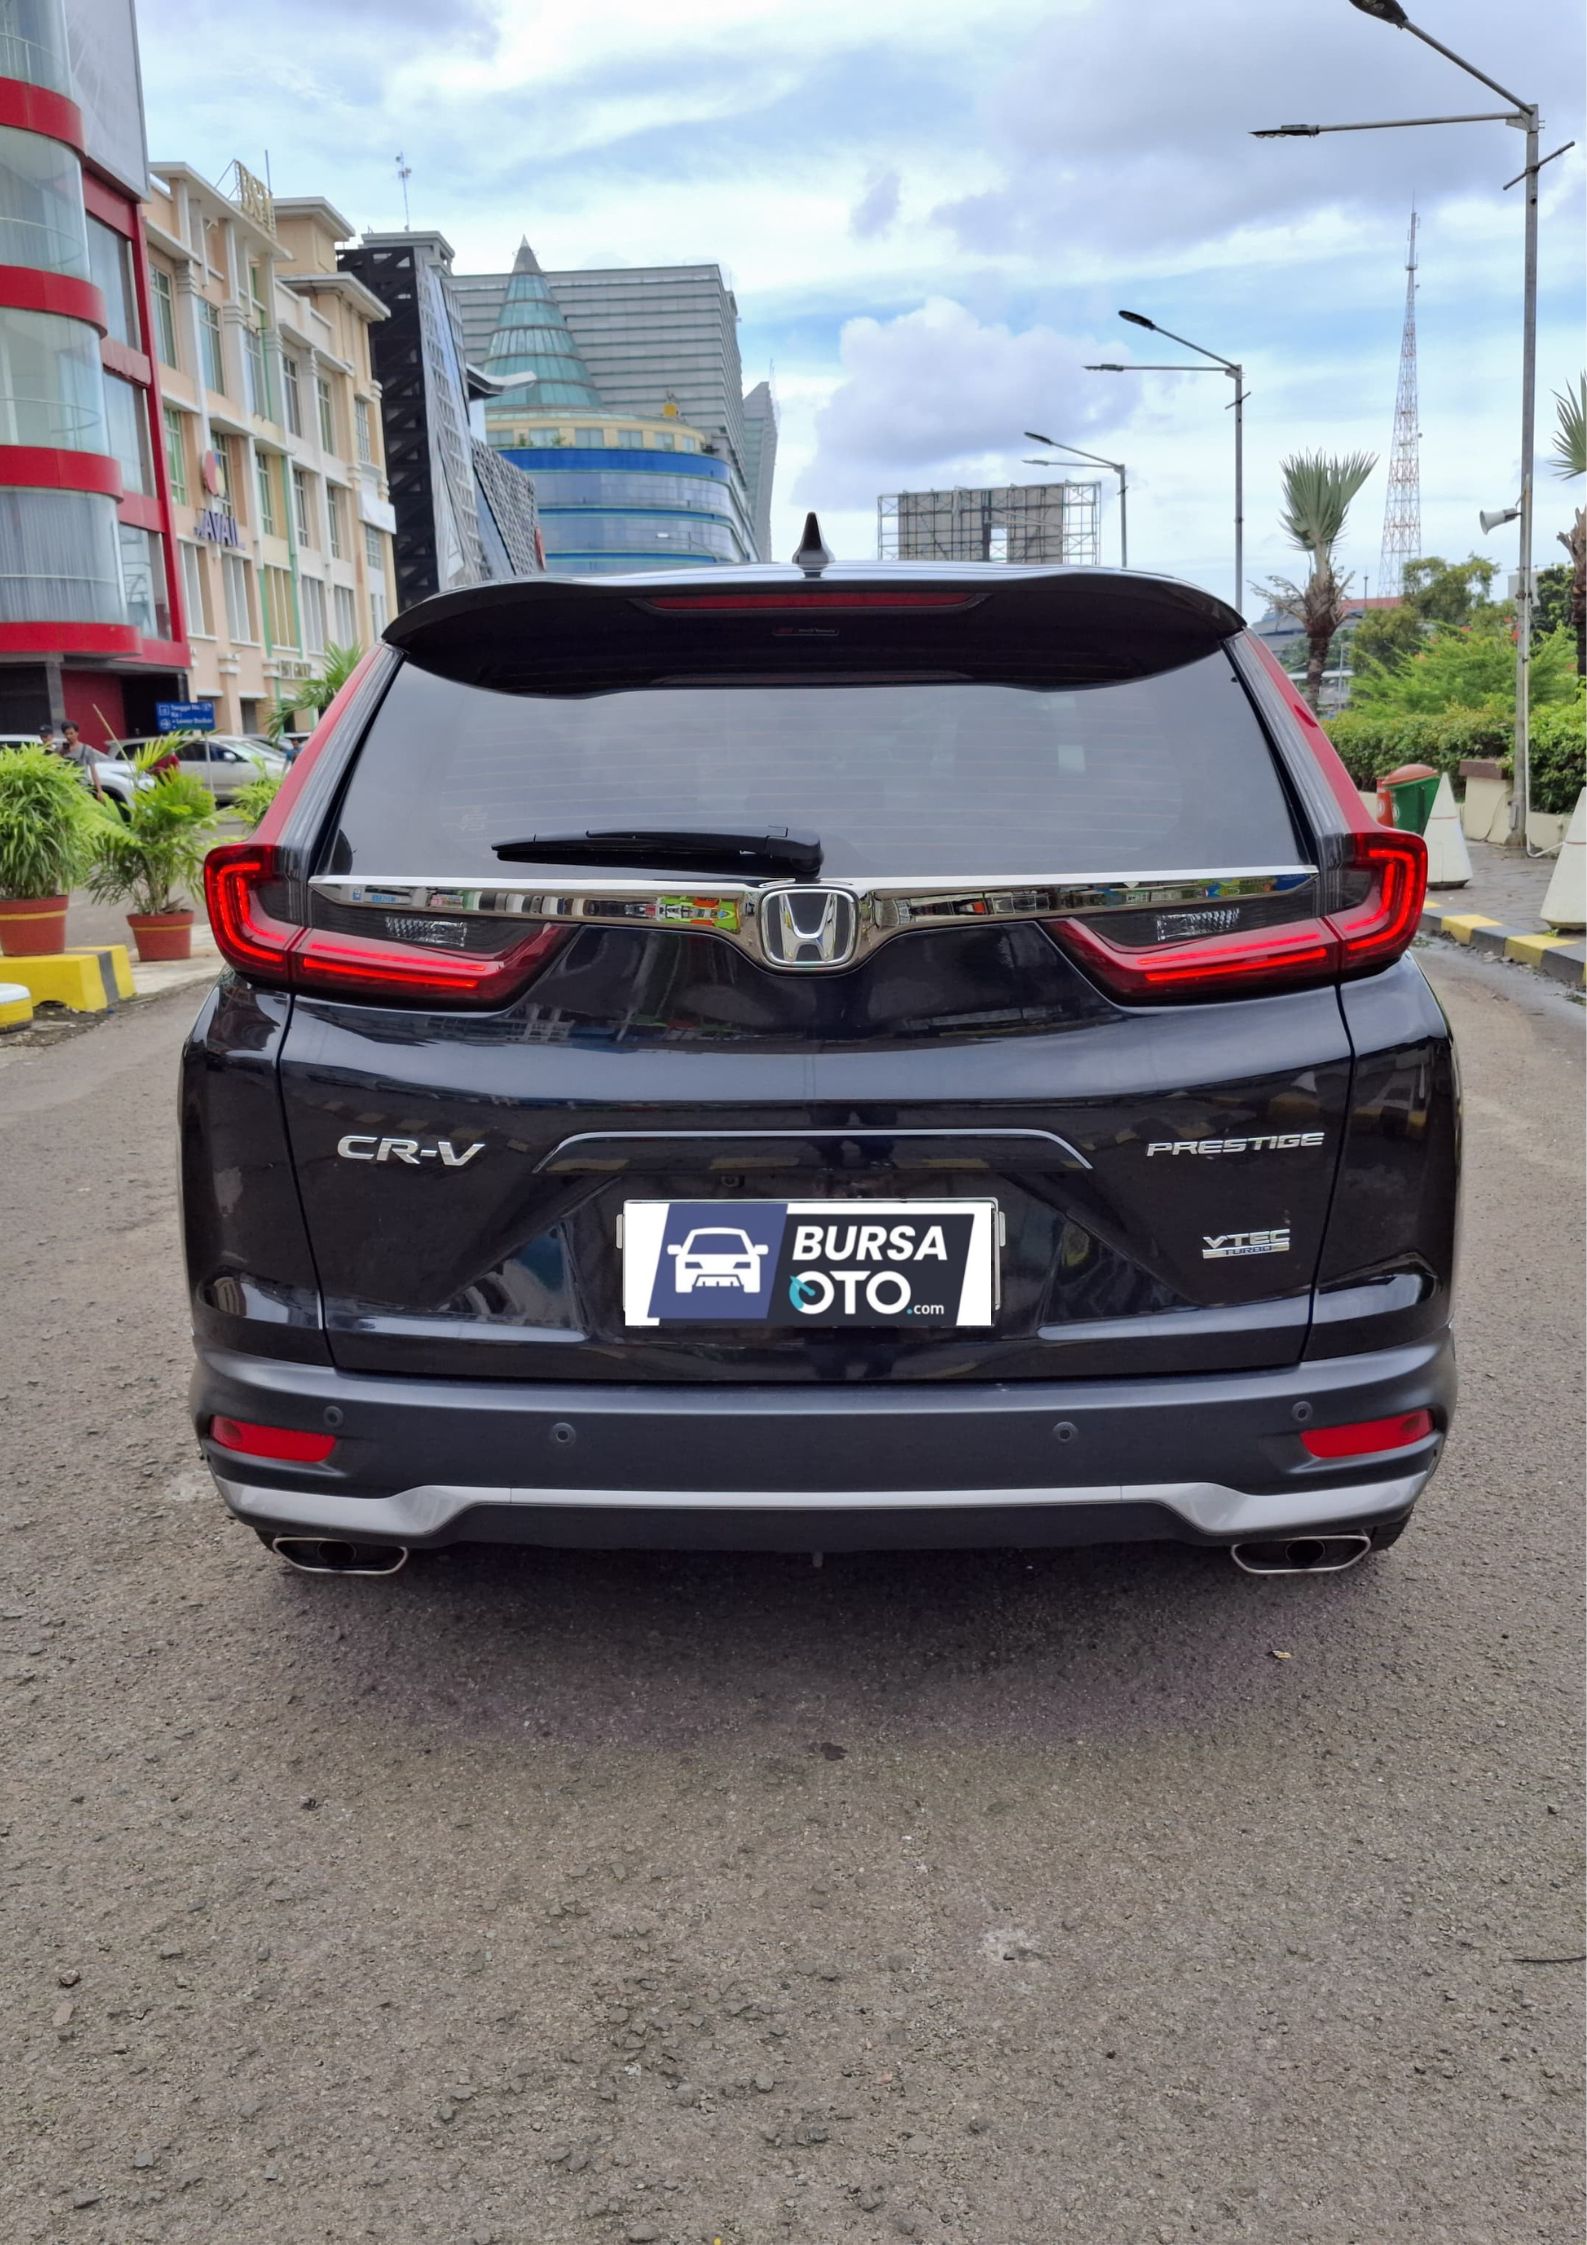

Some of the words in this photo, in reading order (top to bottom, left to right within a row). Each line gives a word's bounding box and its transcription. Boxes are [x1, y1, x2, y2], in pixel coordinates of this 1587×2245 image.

[337, 1135, 486, 1167] CR-V
[1147, 1132, 1325, 1157] PRESTIGE
[1202, 1228, 1290, 1249] VTEC
[1223, 1245, 1273, 1256] TURBO
